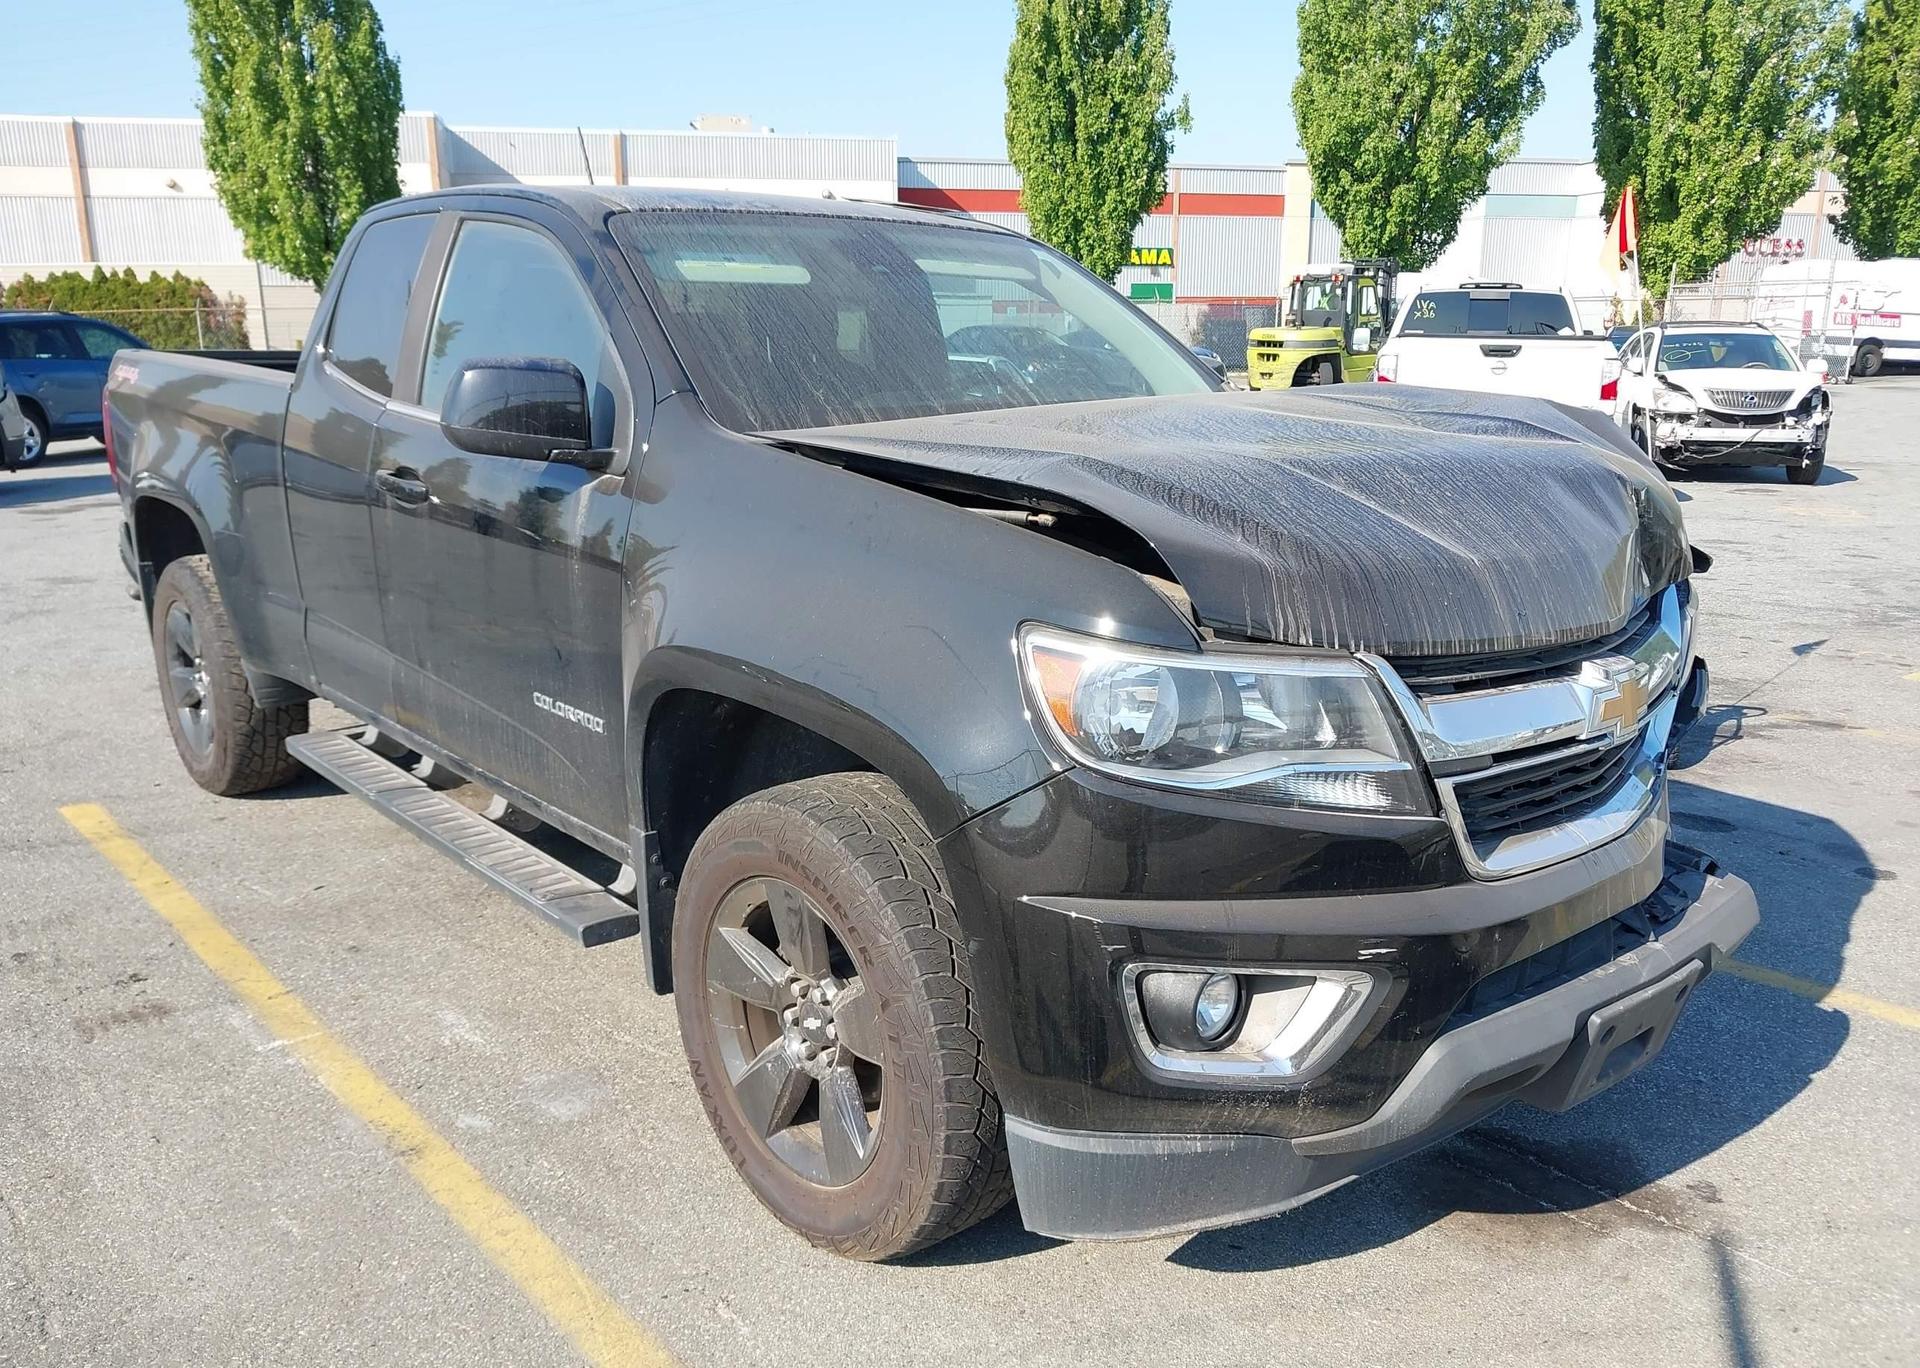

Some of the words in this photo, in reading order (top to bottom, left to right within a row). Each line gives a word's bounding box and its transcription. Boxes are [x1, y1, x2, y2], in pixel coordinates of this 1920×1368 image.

[1835, 313, 1852, 325] ATS
[1856, 314, 1900, 327] Healthcare
[533, 691, 606, 735] COLORADO
